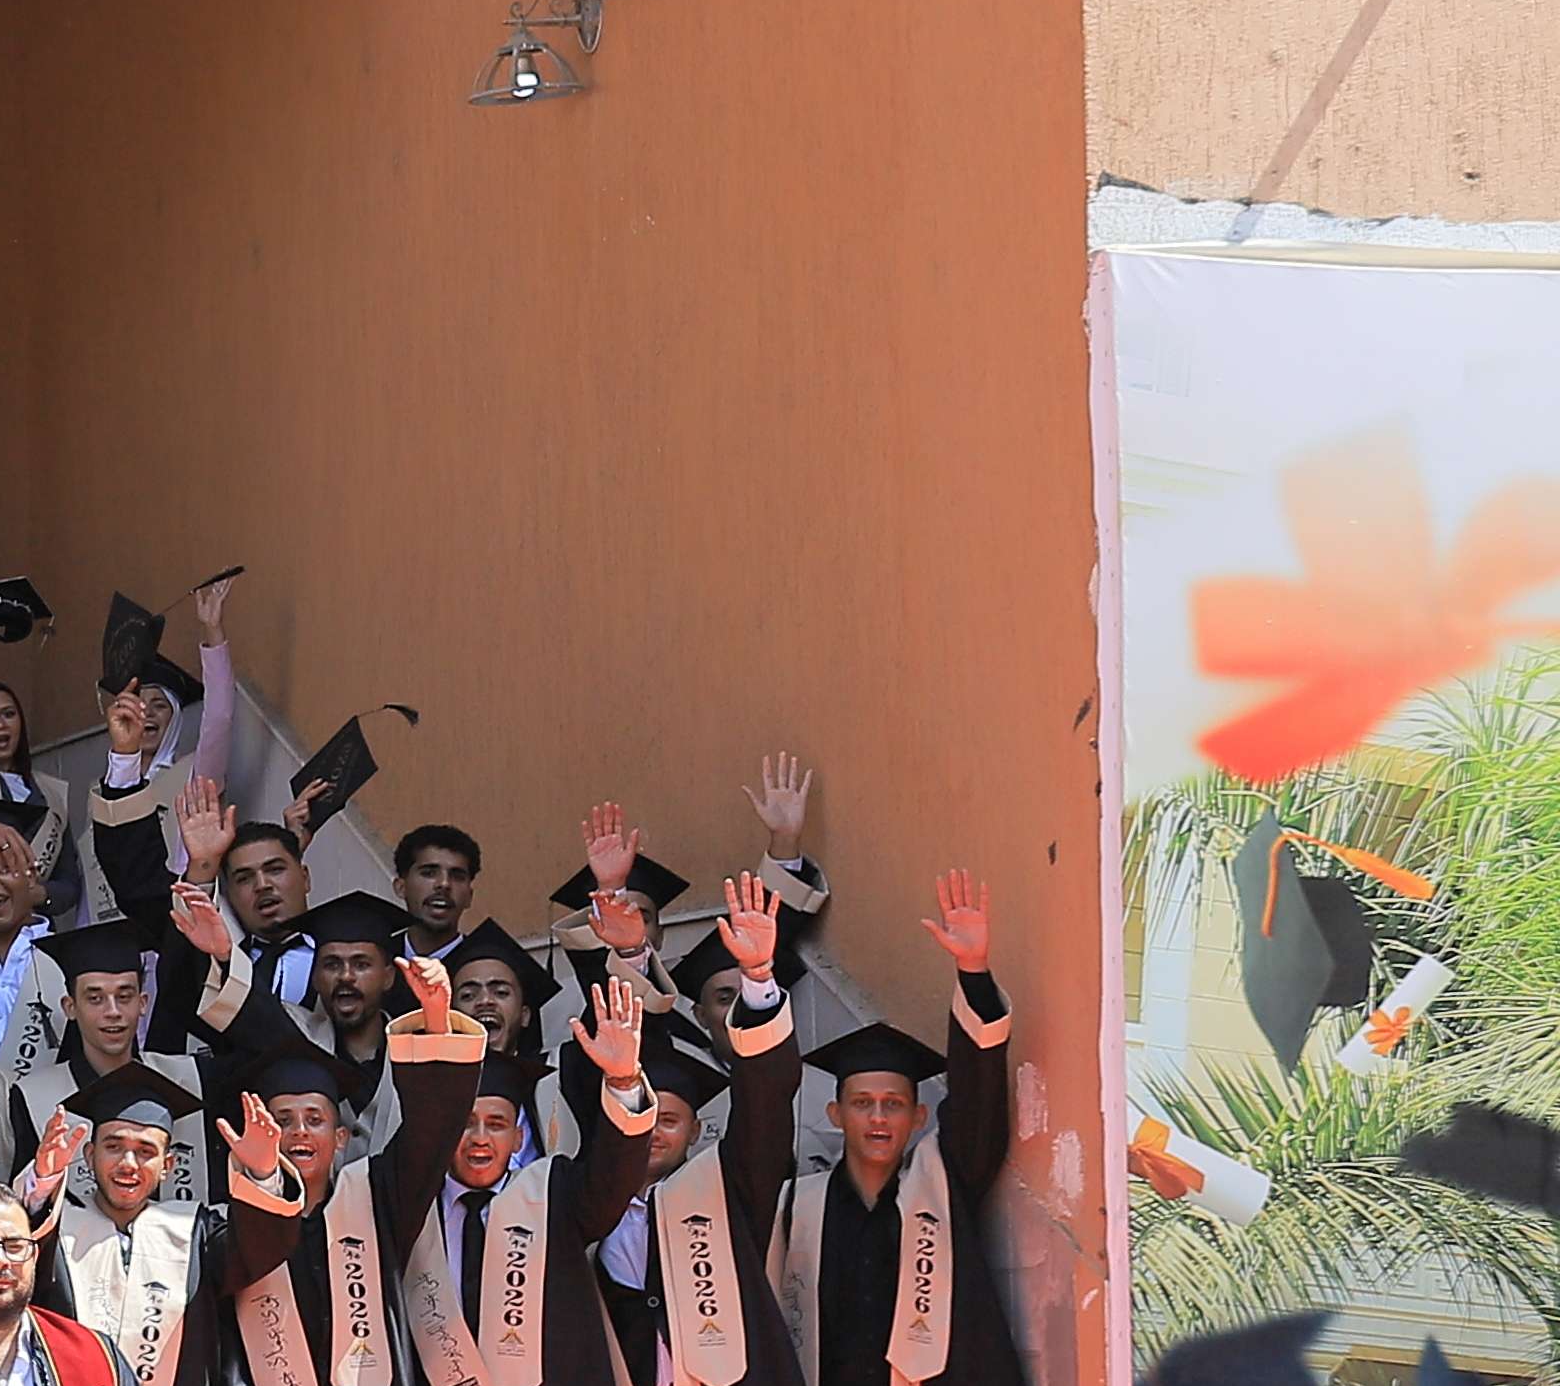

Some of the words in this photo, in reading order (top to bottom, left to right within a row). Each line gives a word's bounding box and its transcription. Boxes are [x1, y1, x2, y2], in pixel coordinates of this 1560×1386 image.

[15, 1024, 42, 1081] 202
[344, 1262, 371, 1339] 2026
[503, 1250, 527, 1327] 2026
[689, 1241, 719, 1317] 2026
[914, 1237, 936, 1314] 2026
[135, 1306, 163, 1382] 2026
